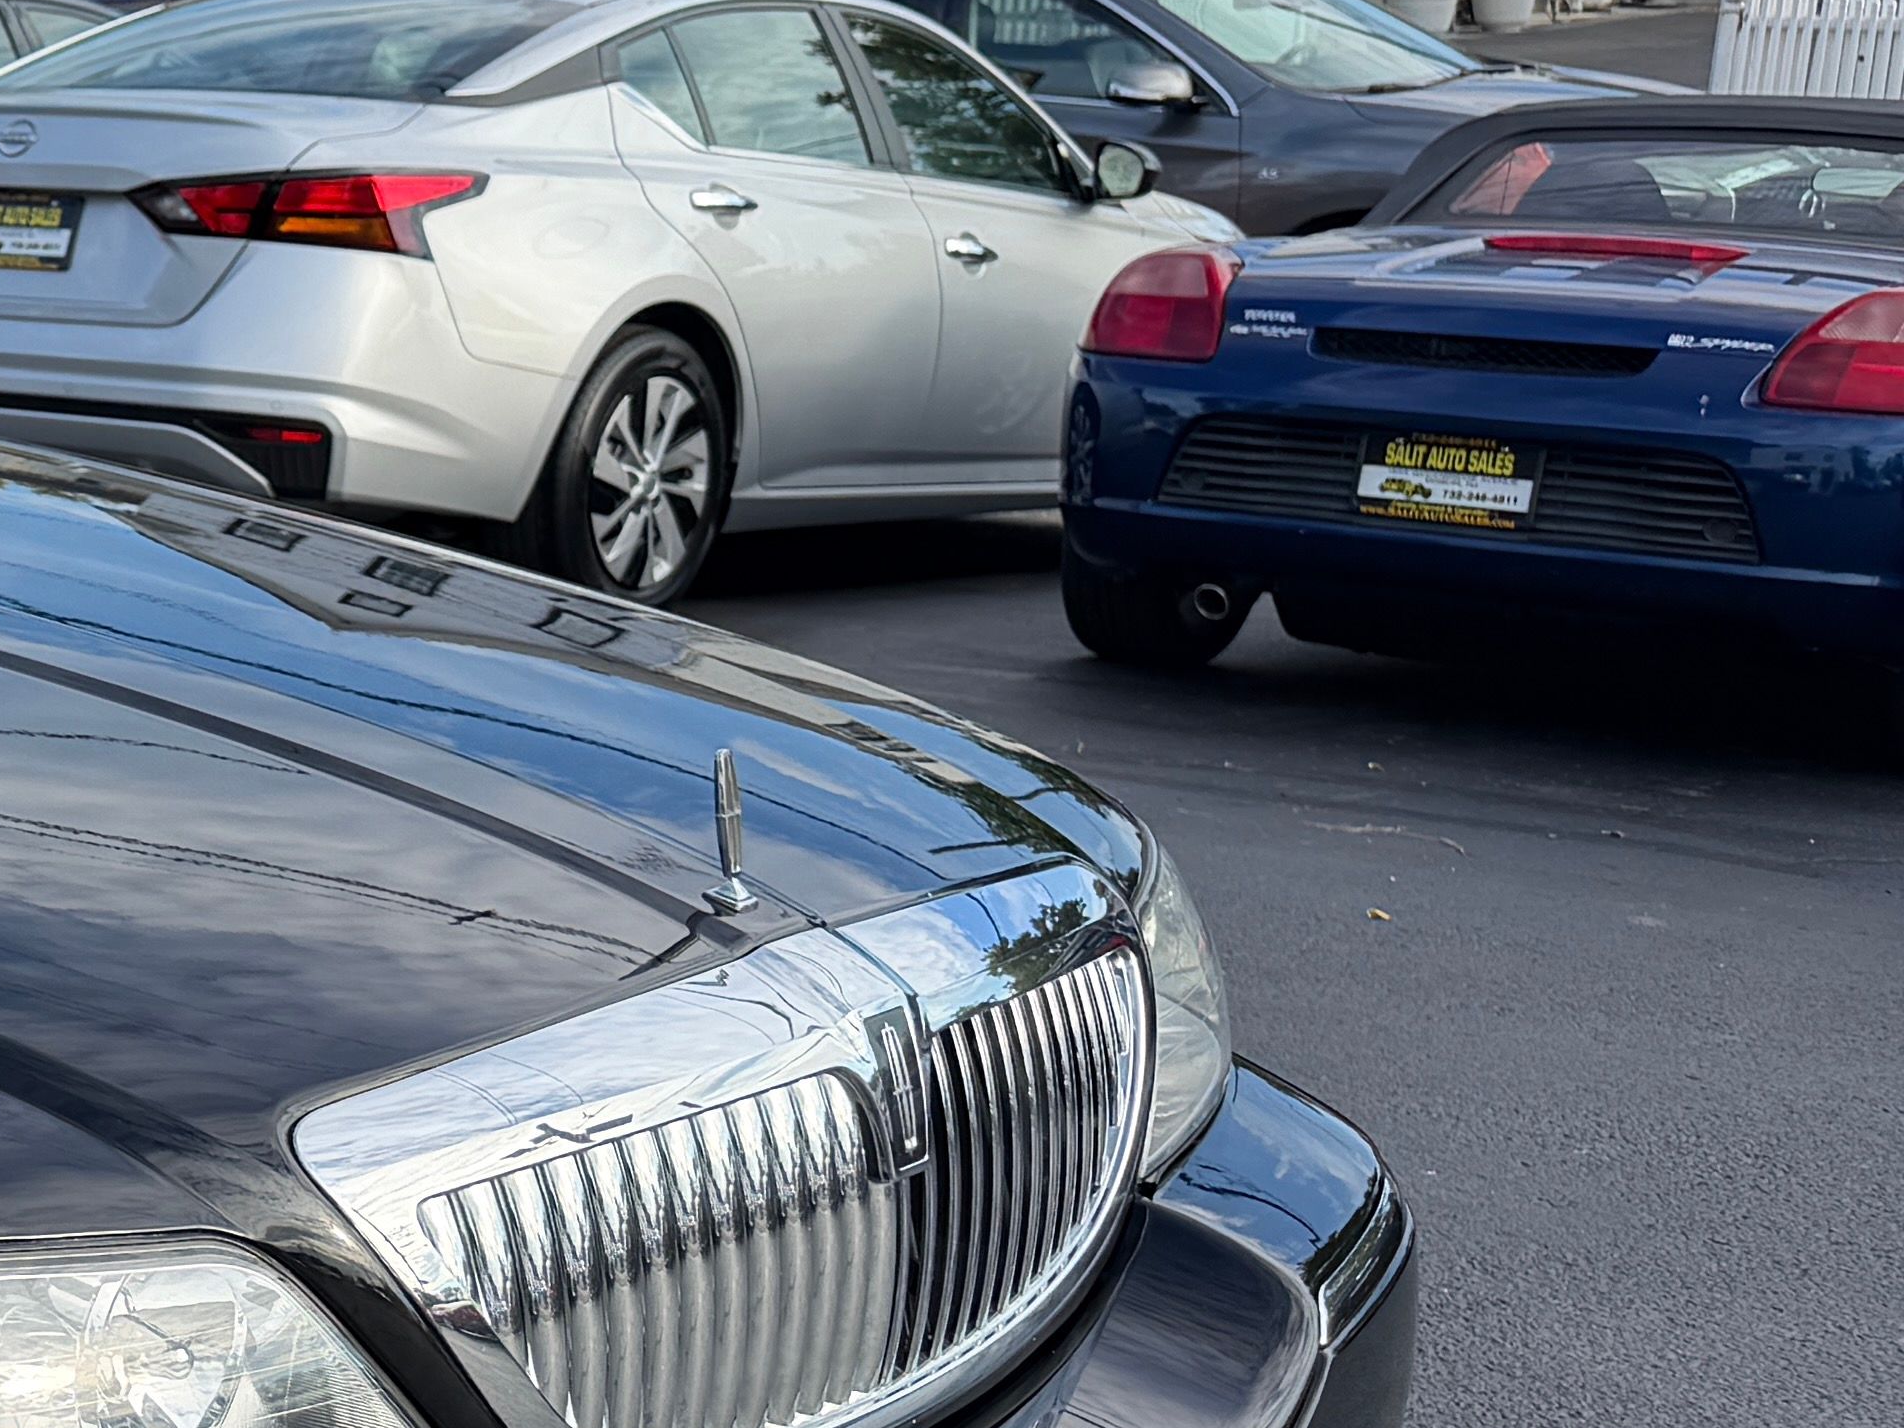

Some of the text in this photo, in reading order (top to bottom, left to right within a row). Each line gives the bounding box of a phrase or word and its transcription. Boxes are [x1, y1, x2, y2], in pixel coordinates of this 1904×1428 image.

[1385, 441, 1428, 468] SALIT
[1426, 445, 1467, 472] AUTO
[1468, 449, 1515, 477] SALES
